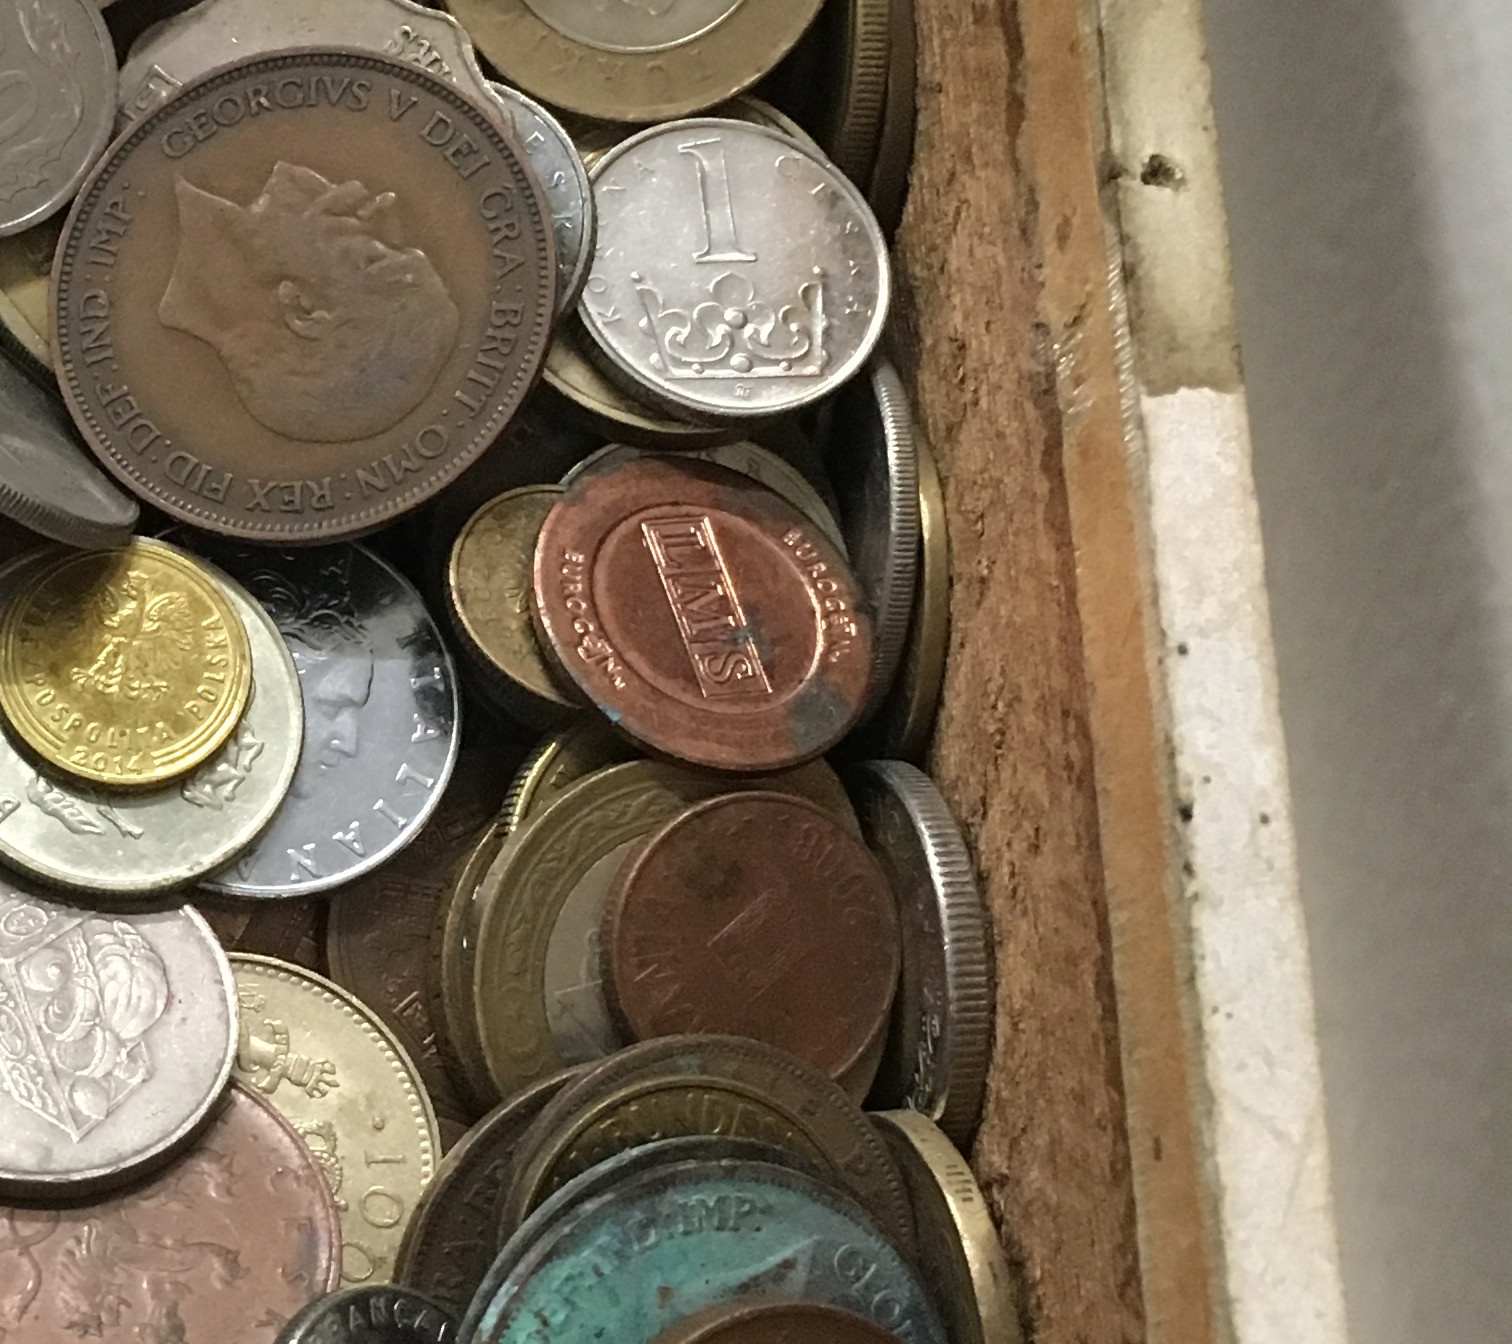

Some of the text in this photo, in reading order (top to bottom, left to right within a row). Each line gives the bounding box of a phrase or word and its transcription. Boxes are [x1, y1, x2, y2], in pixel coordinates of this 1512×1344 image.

[158, 75, 375, 161] GEORGIVS
[388, 88, 420, 123] V
[417, 109, 493, 179] DEI
[677, 136, 757, 264] 1
[243, 476, 336, 516] REX
[185, 613, 232, 723] POLSKA
[69, 744, 146, 777] 2014
